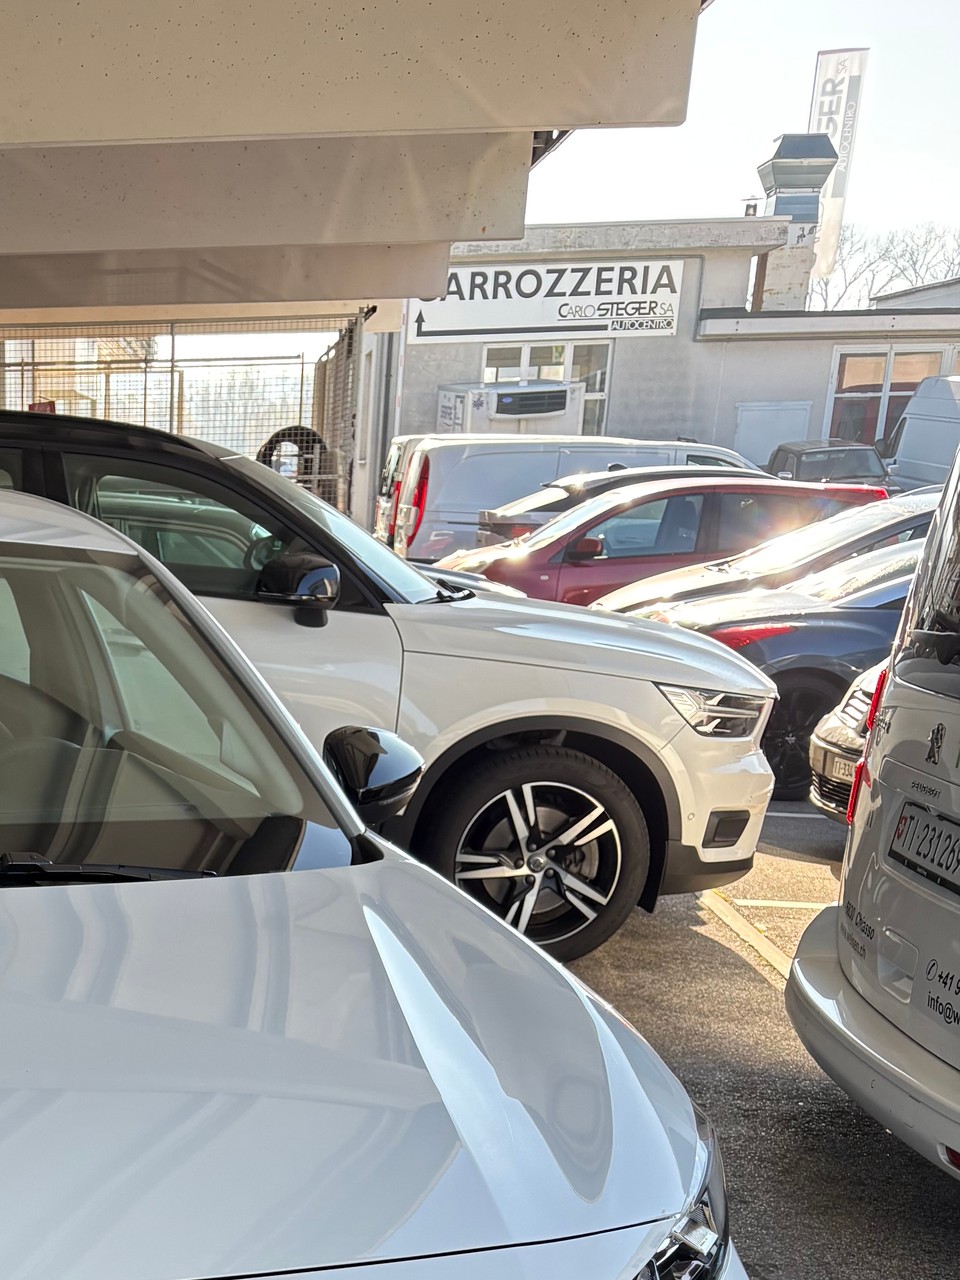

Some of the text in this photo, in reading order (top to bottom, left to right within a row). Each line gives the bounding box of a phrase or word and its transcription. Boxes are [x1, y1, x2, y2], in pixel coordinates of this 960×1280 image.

[419, 265, 677, 302] ARROZZERIA
[596, 301, 658, 317] STEGER
[659, 302, 674, 315] SA
[612, 319, 673, 331] AUTOCENTRO
[854, 911, 875, 940] Chiasso
